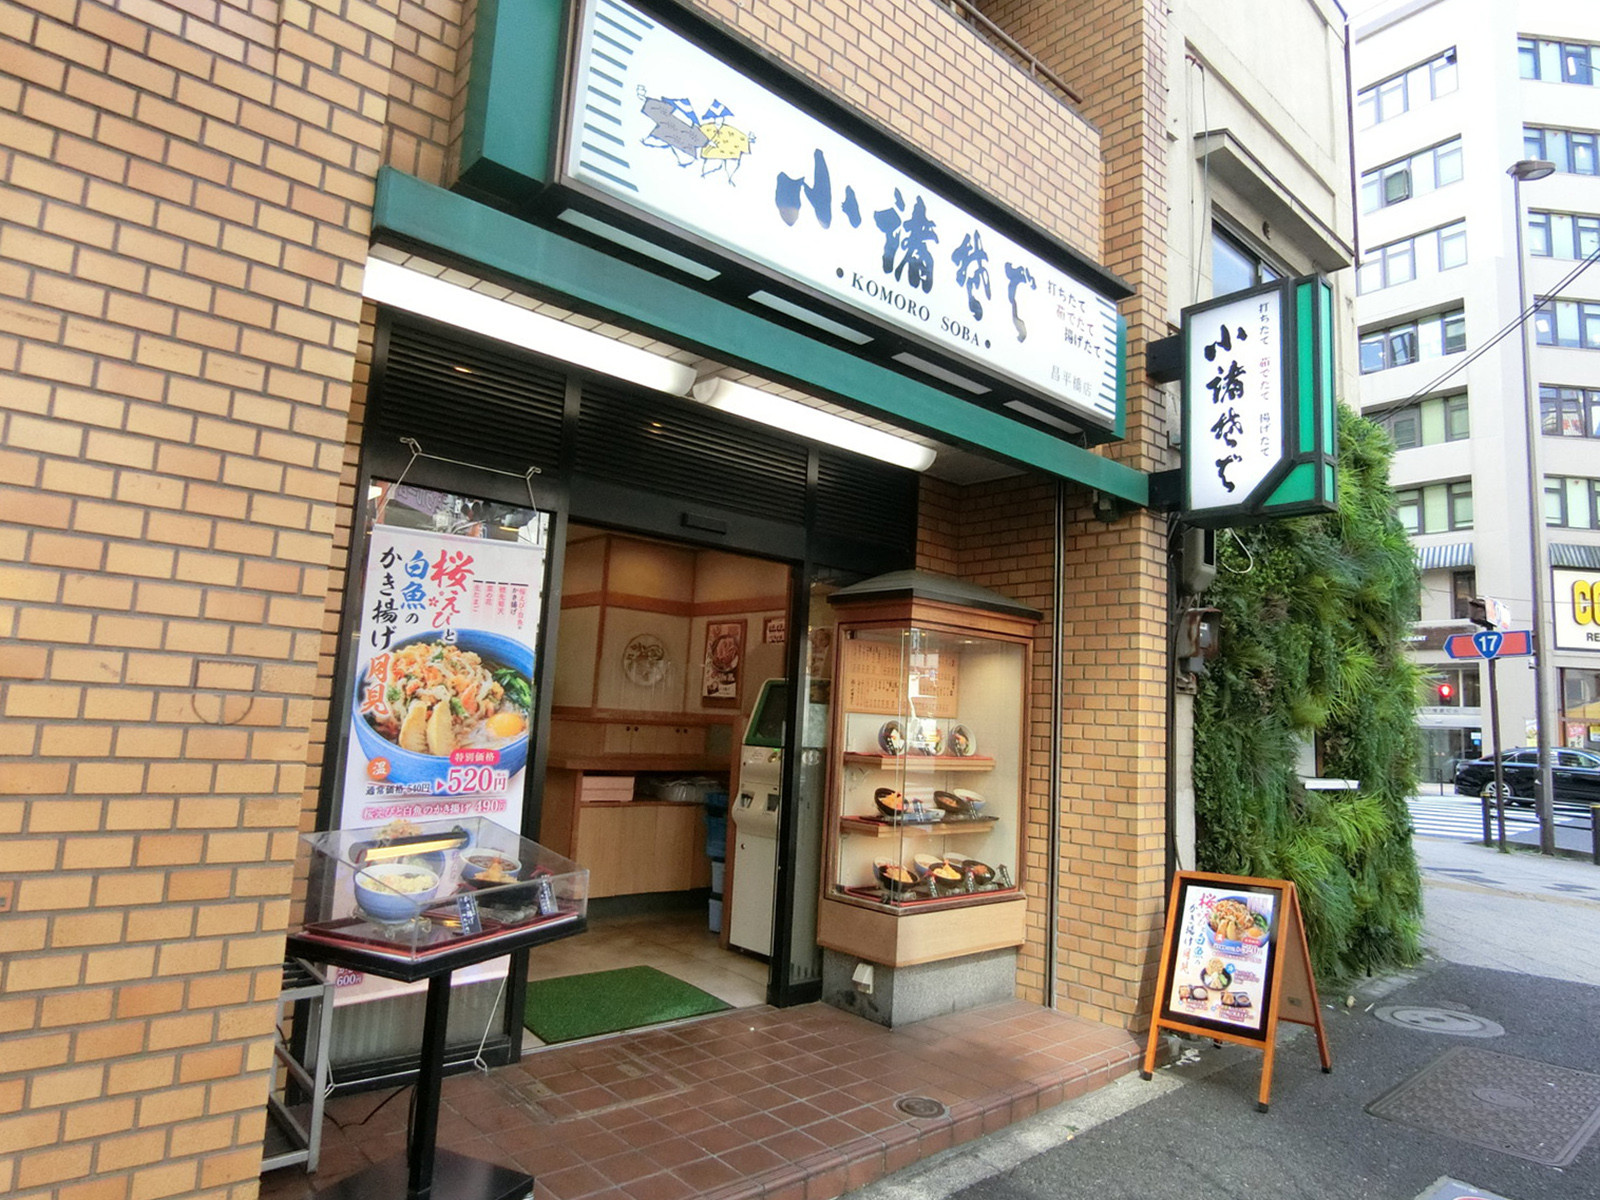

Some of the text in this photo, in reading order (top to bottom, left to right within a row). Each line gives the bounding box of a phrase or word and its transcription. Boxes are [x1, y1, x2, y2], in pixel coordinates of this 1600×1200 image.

[851, 272, 980, 347] KOMORO SOBA
[1048, 280, 1086, 314] 打ちたて
[400, 549, 430, 624] 白魚の
[1478, 635, 1498, 652] 17
